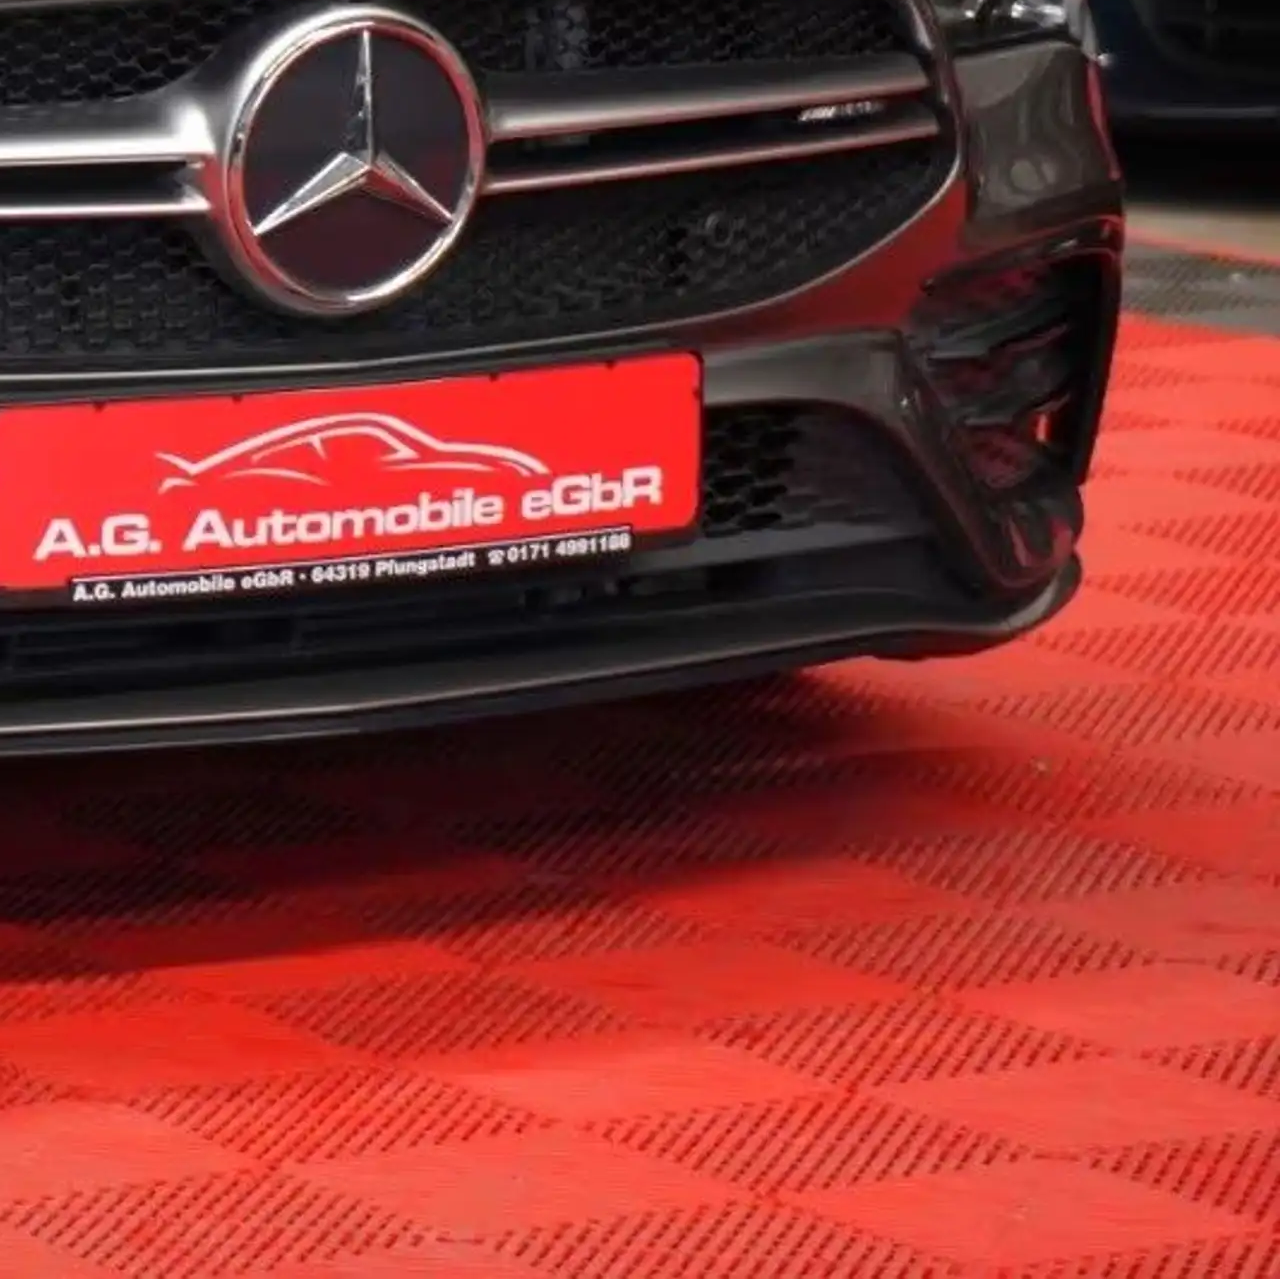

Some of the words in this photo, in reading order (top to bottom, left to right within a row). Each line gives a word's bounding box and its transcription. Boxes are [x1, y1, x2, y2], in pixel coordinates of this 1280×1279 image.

[32, 513, 162, 562] A.G.
[182, 488, 504, 552] Automobile
[521, 466, 662, 521] eGbR
[73, 582, 116, 602] A.G.
[121, 572, 236, 599] Automobile
[240, 568, 294, 591] eGbR
[311, 562, 371, 584] 64319
[375, 551, 475, 577] Pfungstadt
[507, 542, 550, 563] 0171
